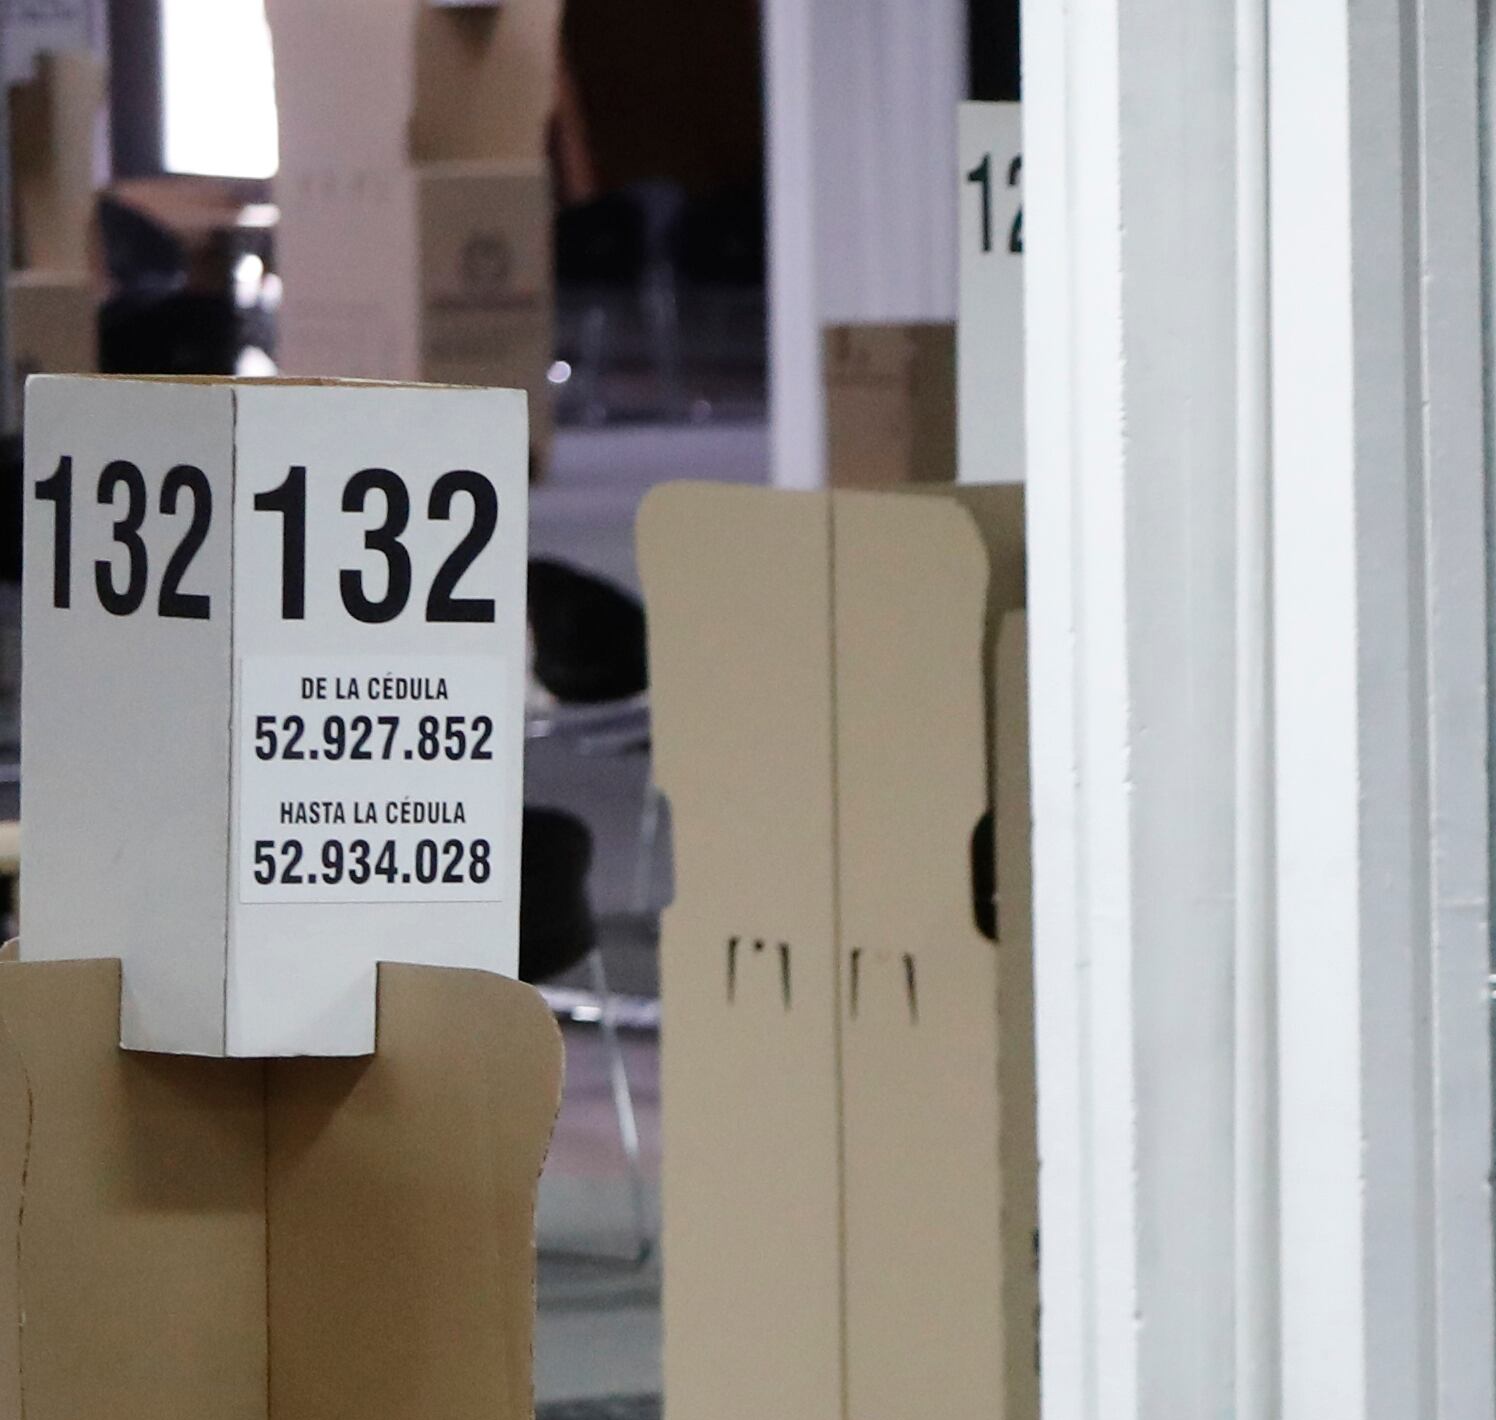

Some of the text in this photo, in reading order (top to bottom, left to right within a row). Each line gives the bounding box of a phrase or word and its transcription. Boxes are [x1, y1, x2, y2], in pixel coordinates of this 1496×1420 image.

[35, 455, 213, 620] 132
[253, 466, 499, 623] 132
[301, 671, 448, 700] DE LA CÉDULA
[255, 715, 493, 761] 52.927.852
[280, 795, 466, 824] HASTA LA CÉDULA
[254, 838, 491, 885] 52.934.028
